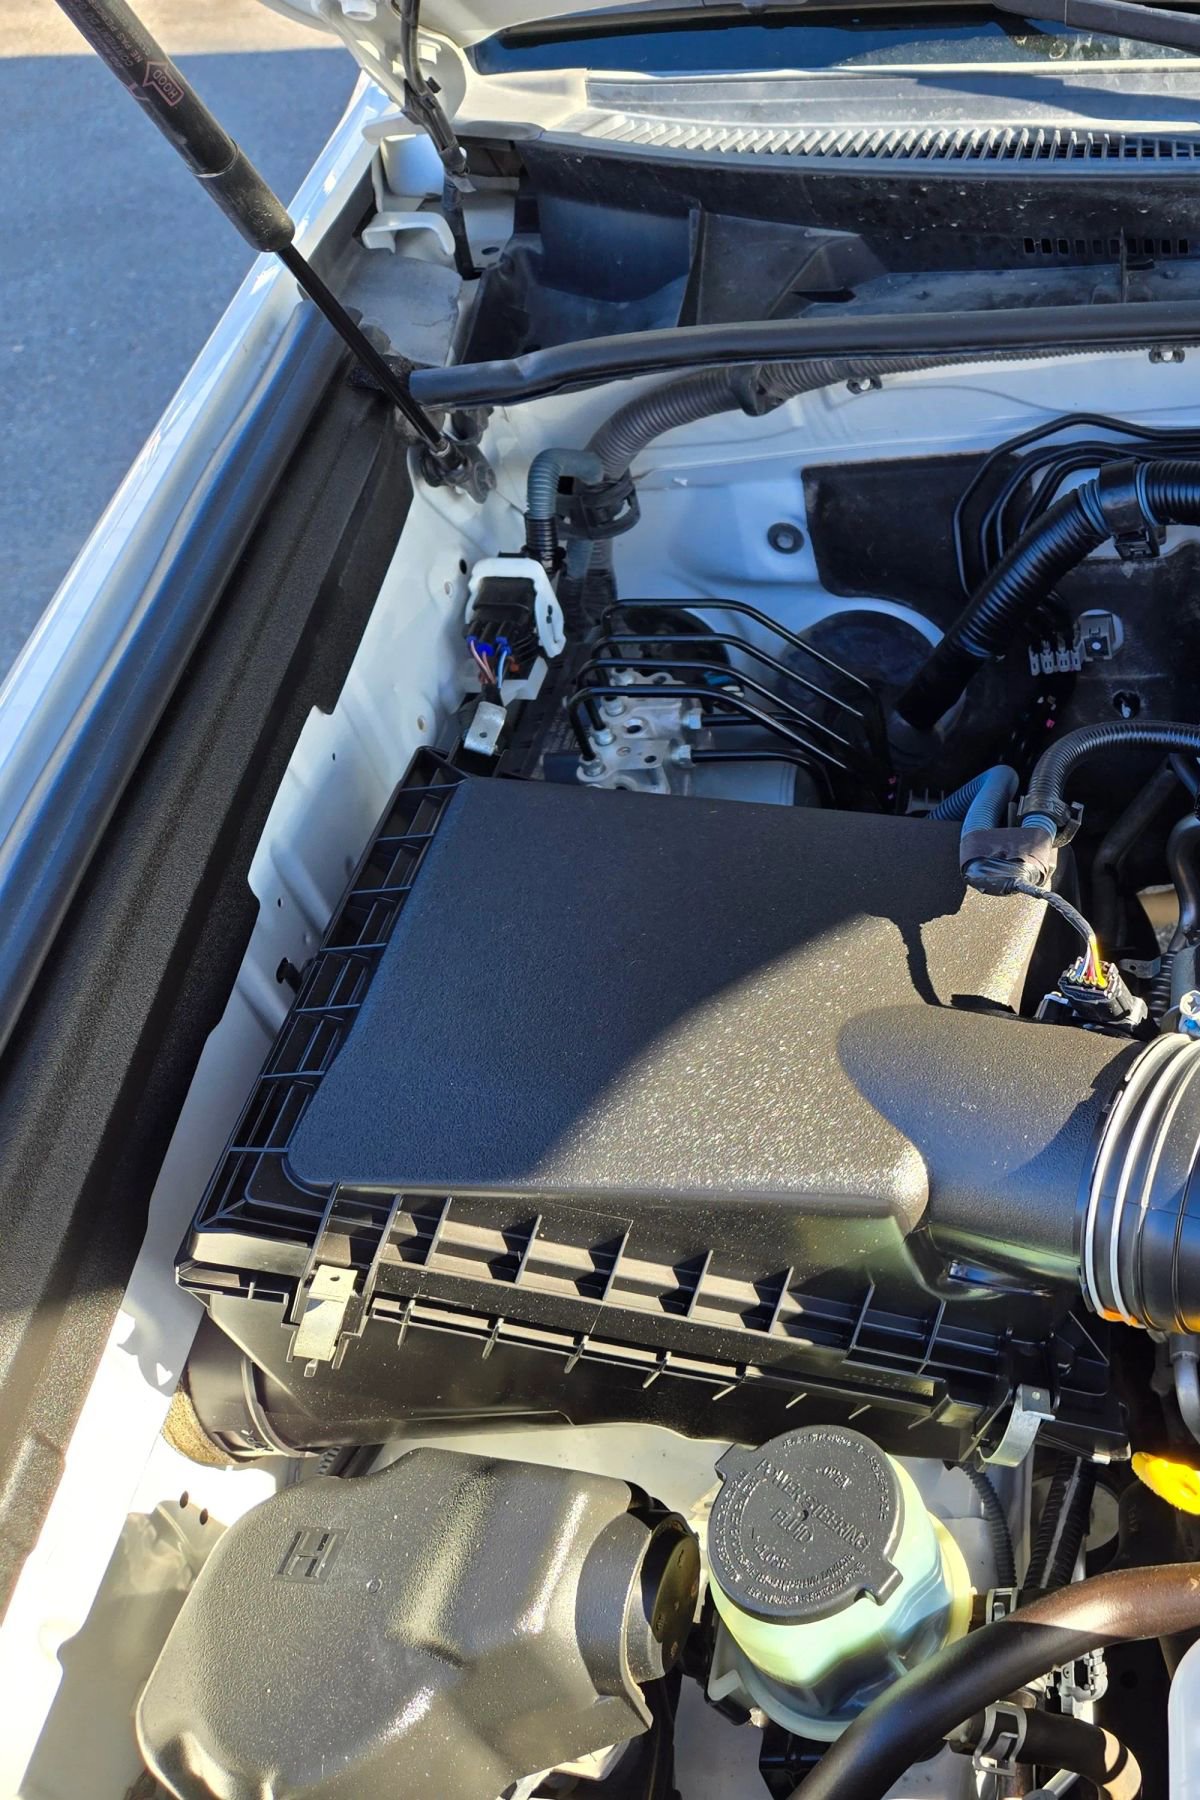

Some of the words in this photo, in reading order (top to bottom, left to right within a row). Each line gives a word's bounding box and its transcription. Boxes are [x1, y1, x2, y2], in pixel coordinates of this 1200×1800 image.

[117, 32, 133, 51] PAS
[130, 49, 144, 63] NE
[153, 69, 180, 100] HOOD
[823, 1464, 853, 1491] OPEN
[755, 1458, 807, 1505] POWER
[804, 1494, 870, 1553] STEERING
[771, 1508, 814, 1543] FLUID
